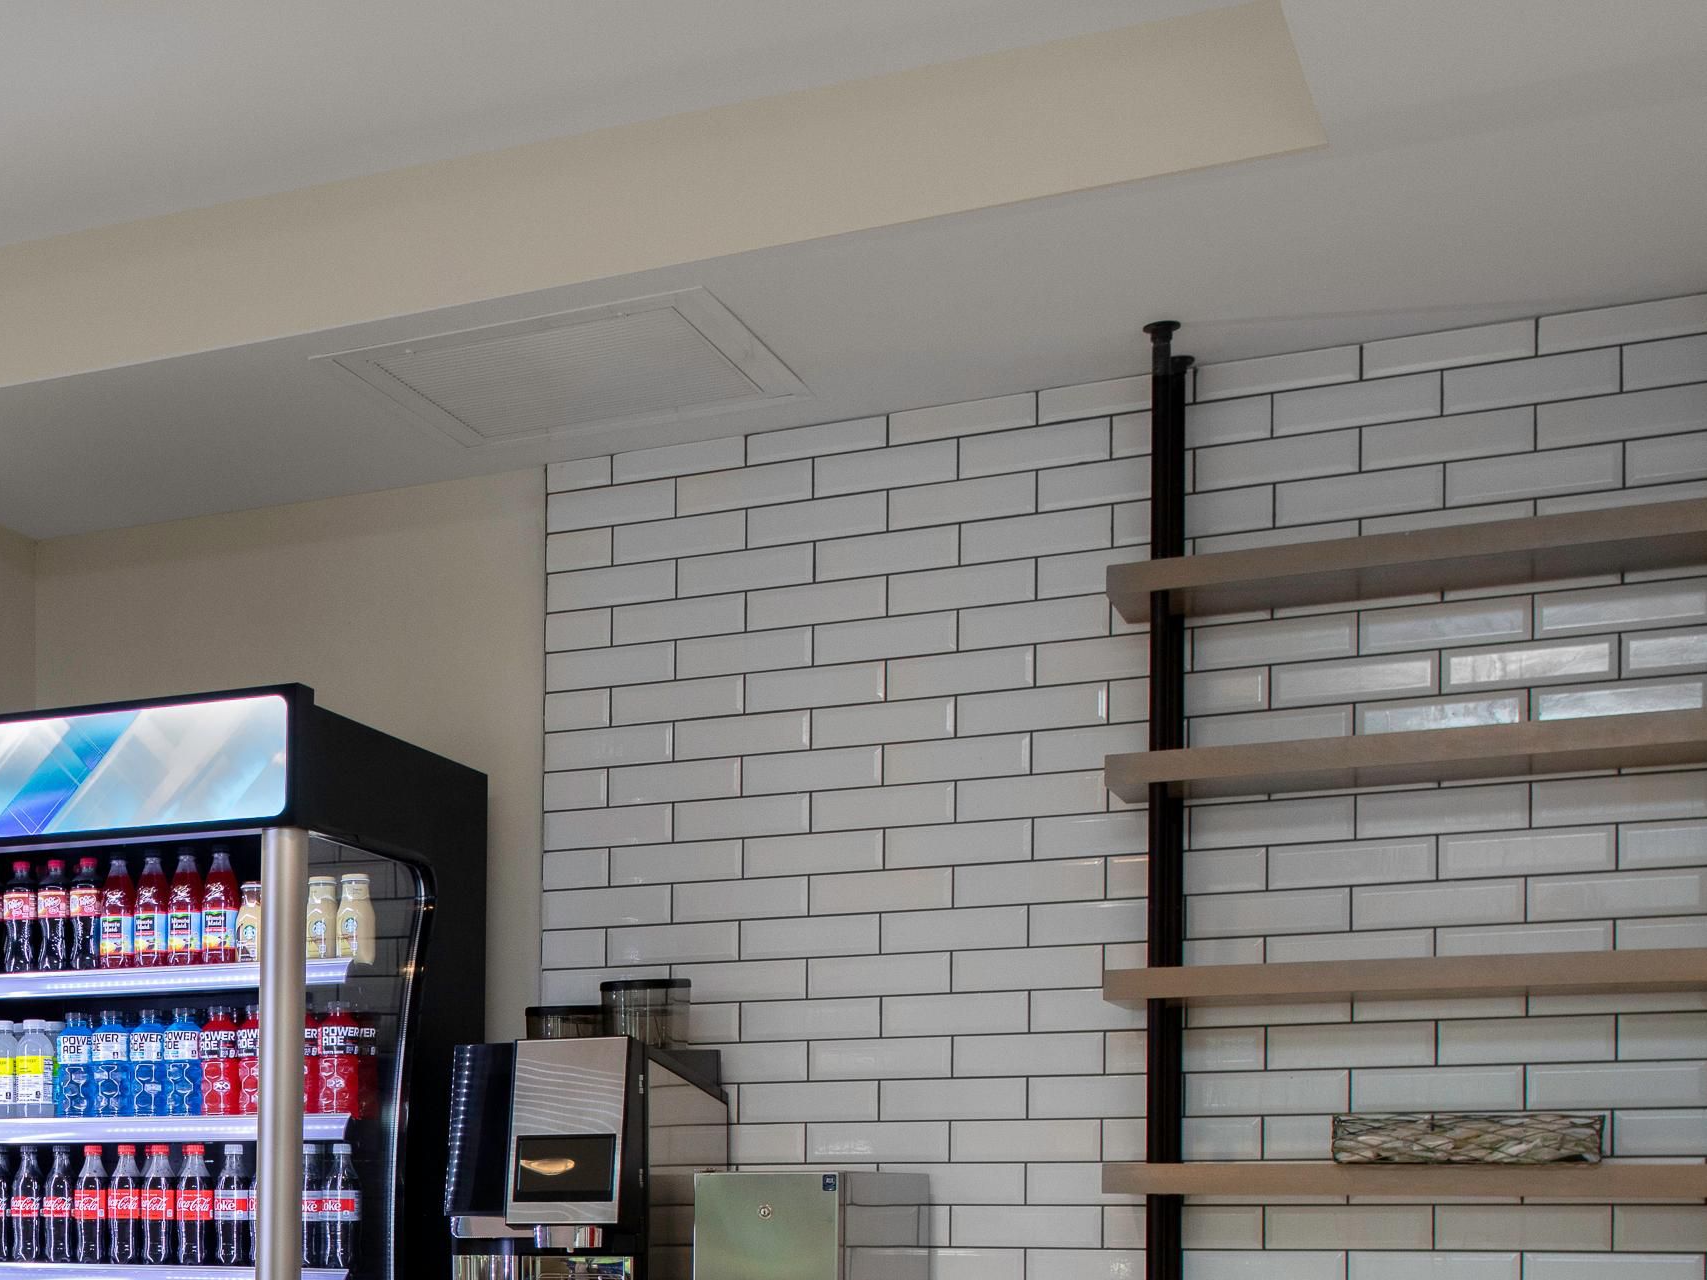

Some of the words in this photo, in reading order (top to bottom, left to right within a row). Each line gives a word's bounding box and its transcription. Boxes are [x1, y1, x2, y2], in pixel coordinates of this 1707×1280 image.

[200, 1031, 235, 1042] POWER
[322, 1027, 359, 1037] POWER
[62, 1036, 92, 1046] POWE
[130, 1033, 163, 1043] POWER
[323, 1036, 344, 1045] ADE
